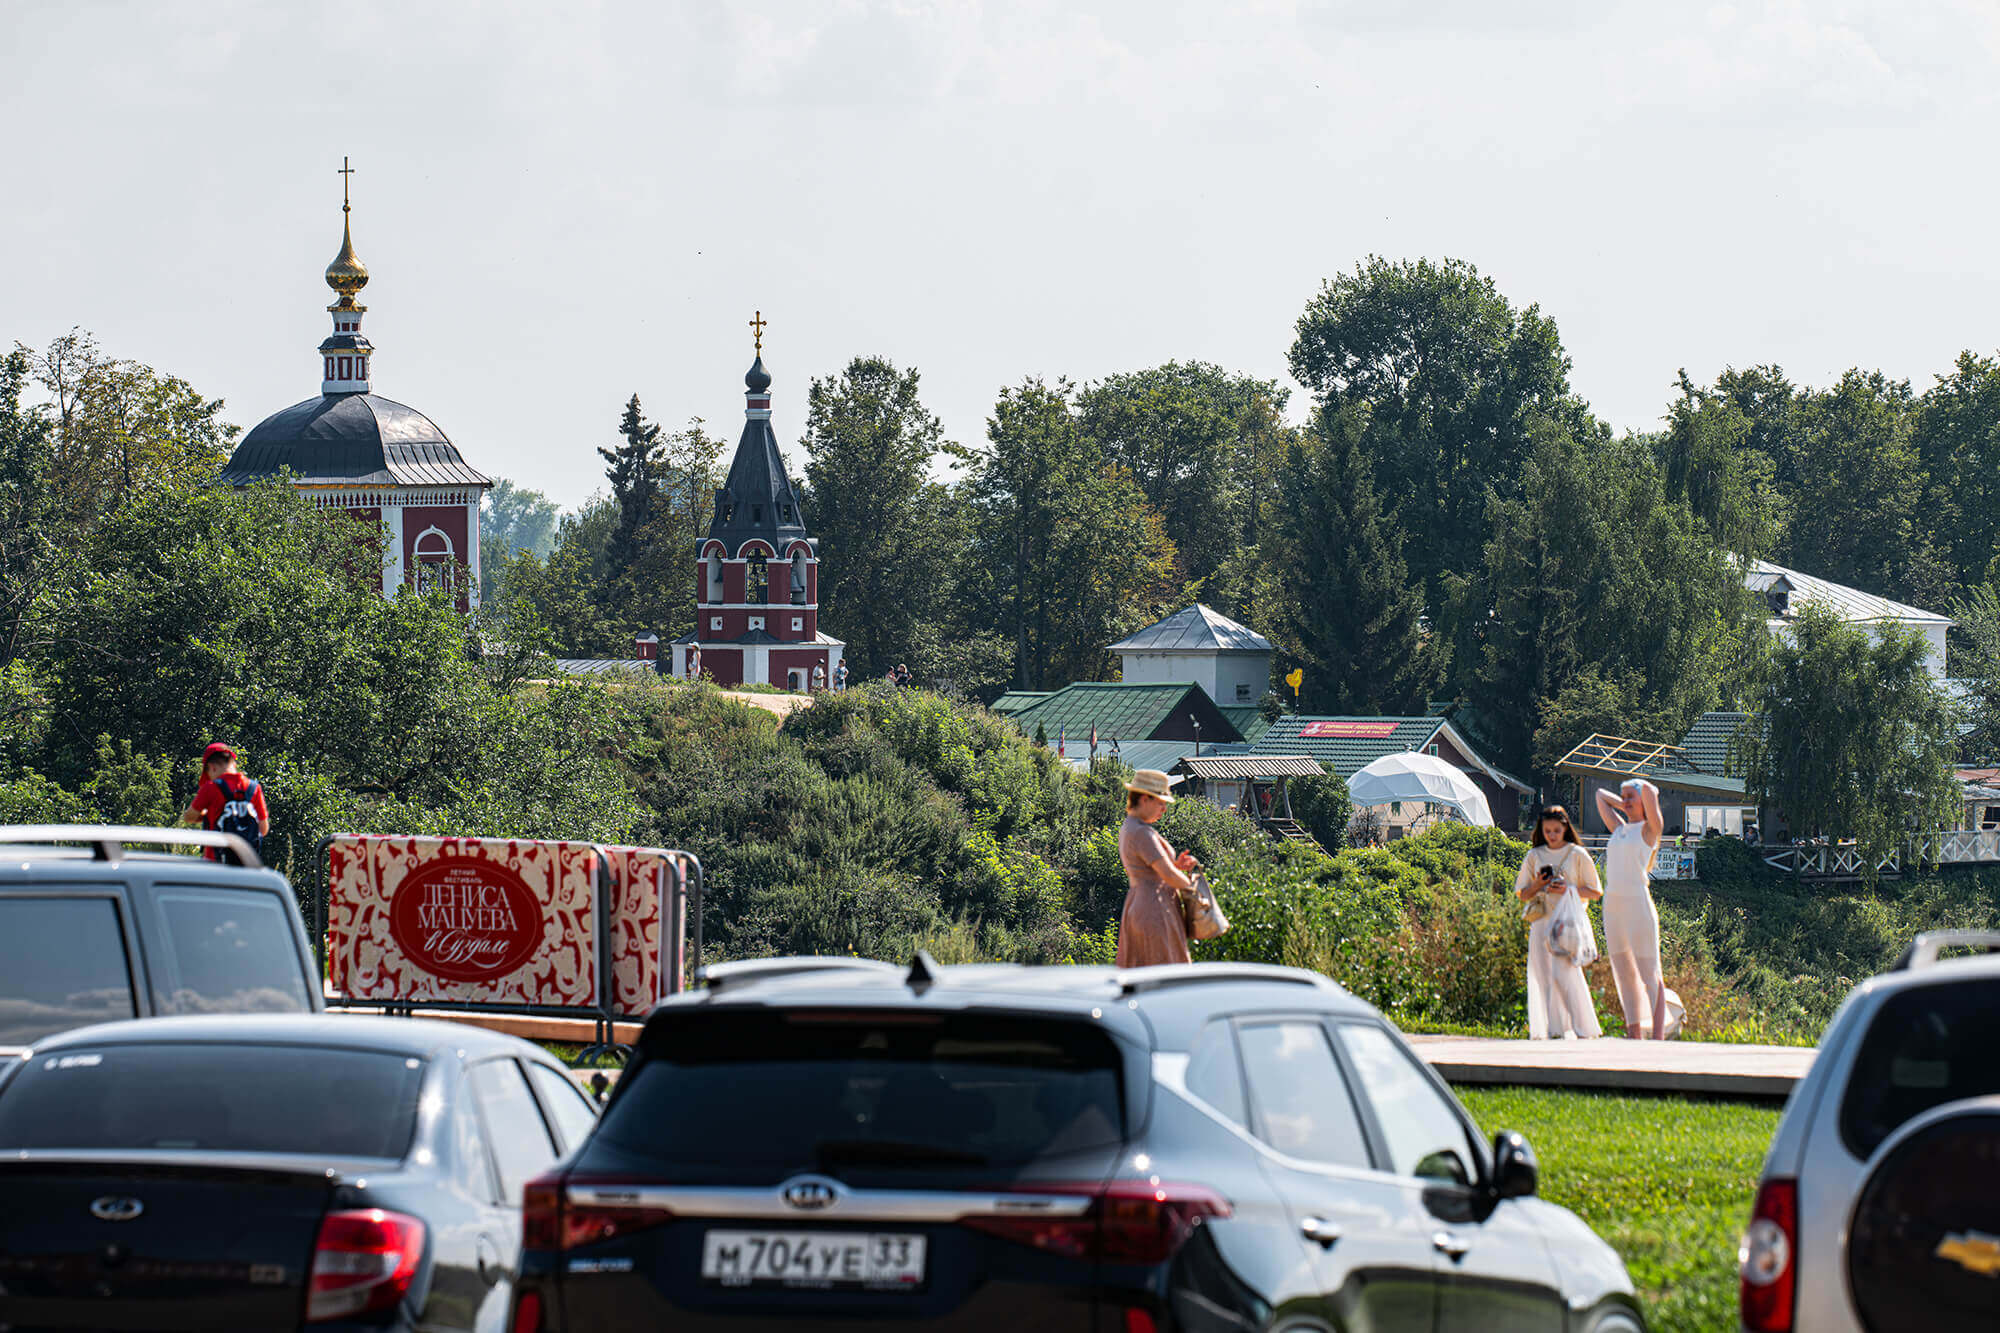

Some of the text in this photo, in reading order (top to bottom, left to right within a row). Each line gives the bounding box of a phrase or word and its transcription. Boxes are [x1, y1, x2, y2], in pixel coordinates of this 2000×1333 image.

[423, 884, 510, 908] ДЕНИСА
[418, 906, 518, 931] МАЦУЕВА
[424, 929, 510, 968] в Суздале
